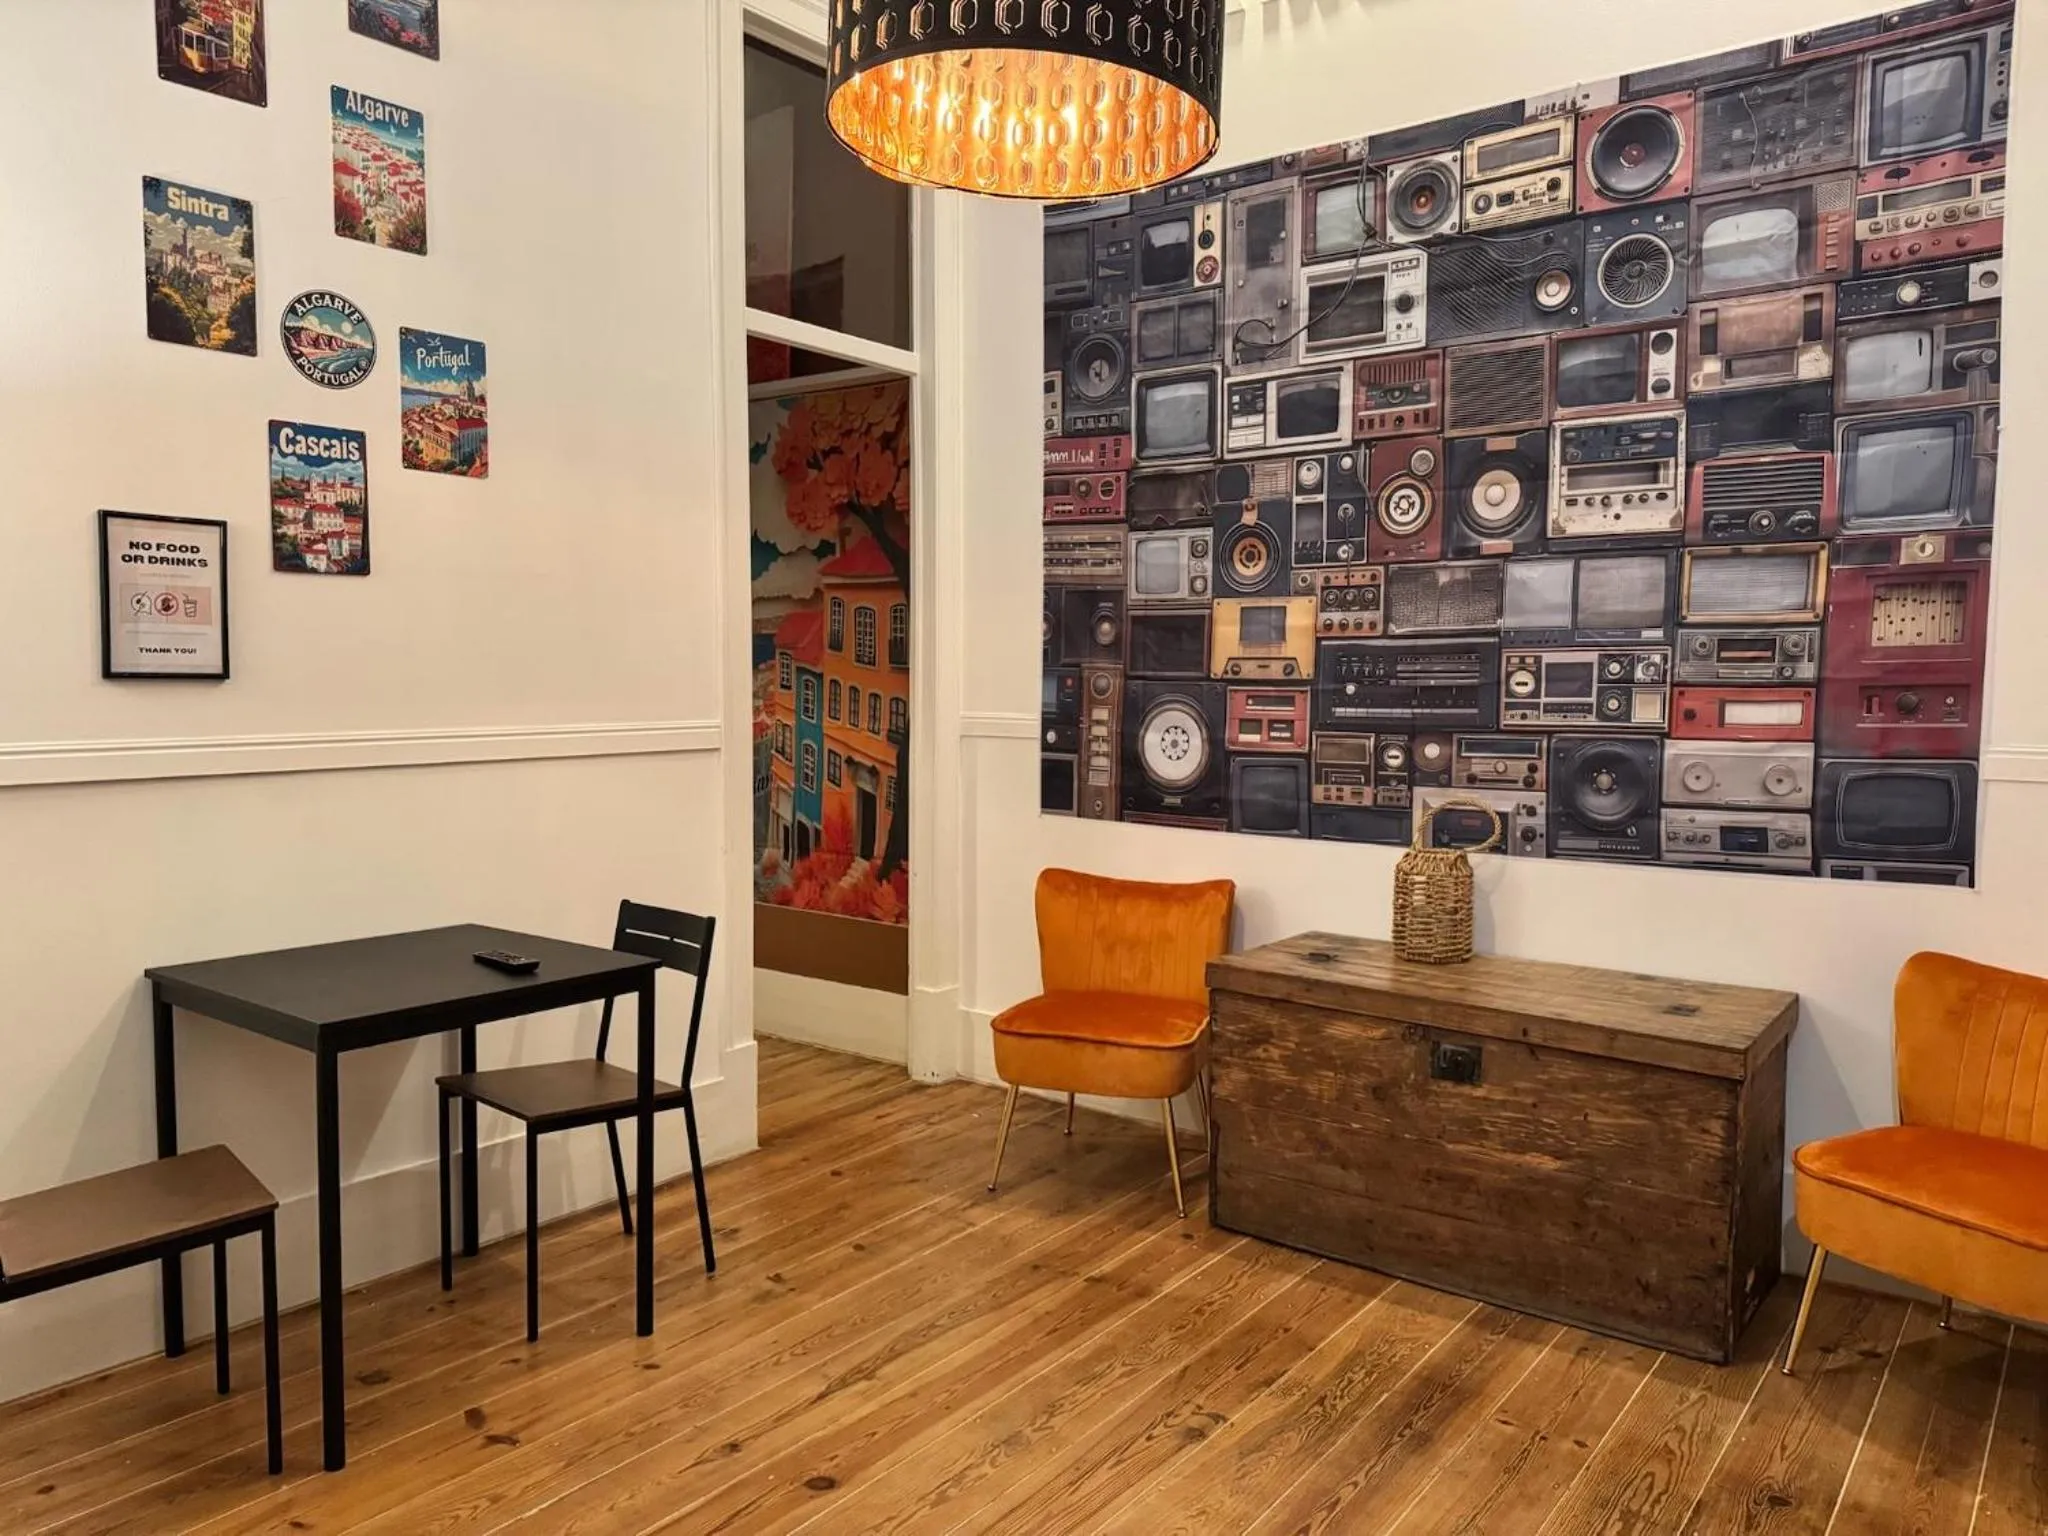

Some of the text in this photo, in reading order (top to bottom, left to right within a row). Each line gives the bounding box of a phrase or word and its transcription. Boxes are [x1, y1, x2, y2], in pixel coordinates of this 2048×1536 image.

[167, 186, 230, 222] Sintra
[294, 294, 362, 324] ALGARVE
[296, 356, 364, 385] PORTUGAL
[416, 343, 471, 376] Portugal
[279, 427, 361, 461] Cascais
[121, 554, 209, 568] OR DRINKS
[129, 541, 201, 554] NO FOOD
